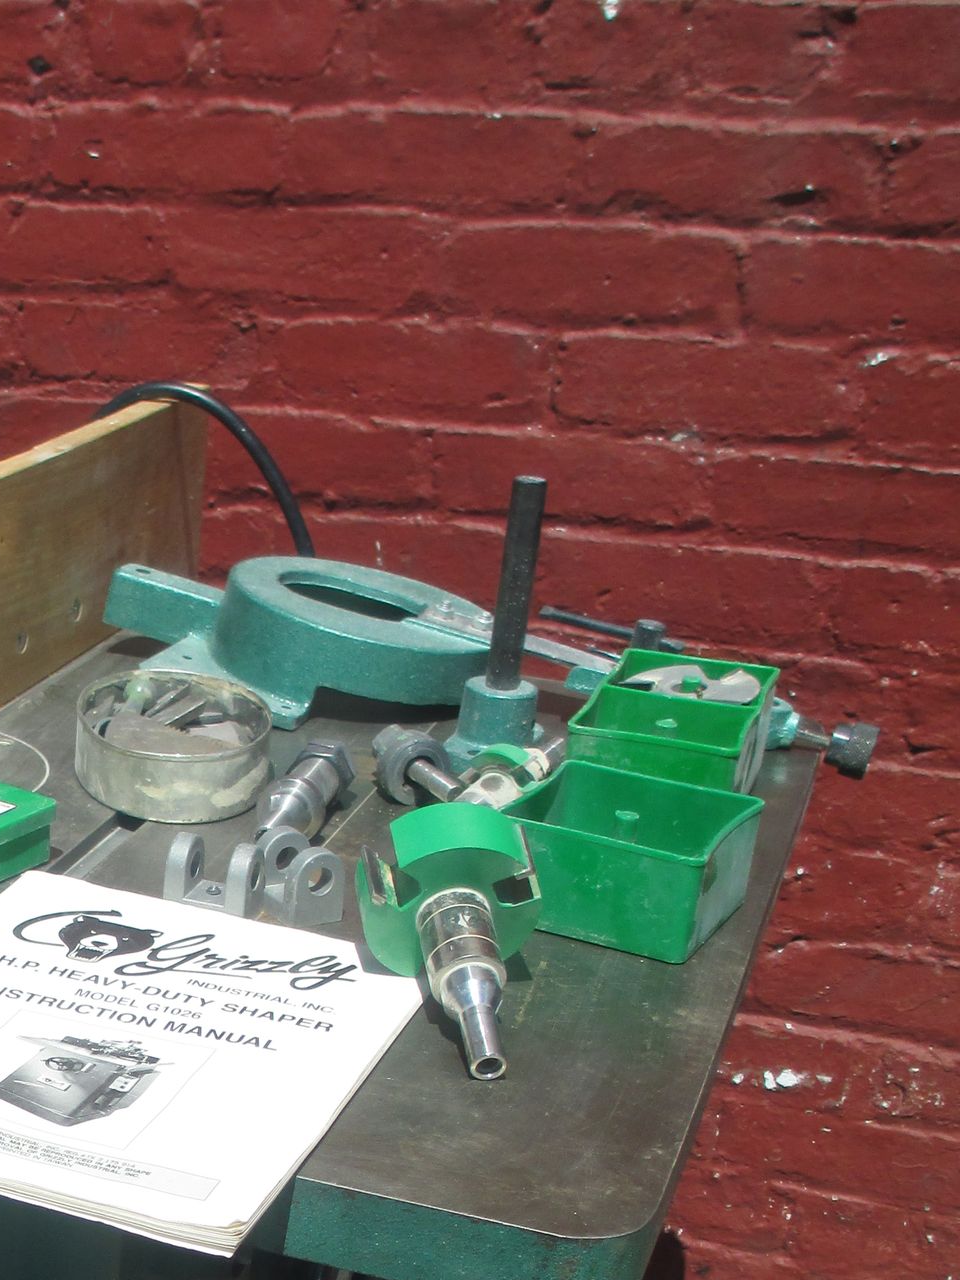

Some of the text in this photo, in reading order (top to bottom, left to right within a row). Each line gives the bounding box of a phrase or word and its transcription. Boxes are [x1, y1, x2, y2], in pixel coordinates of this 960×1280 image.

[114, 934, 357, 990] Grizzly
[48, 965, 215, 1008] HEAVY-DUTY
[221, 1003, 334, 1032] SHAPER
[74, 988, 202, 1020] MODEL G1026
[302, 1002, 337, 1015] INC.
[164, 1021, 277, 1051] MANUAL
[40, 1148, 93, 1163] REPRODUCED
[124, 1167, 152, 1176] SHAPE
